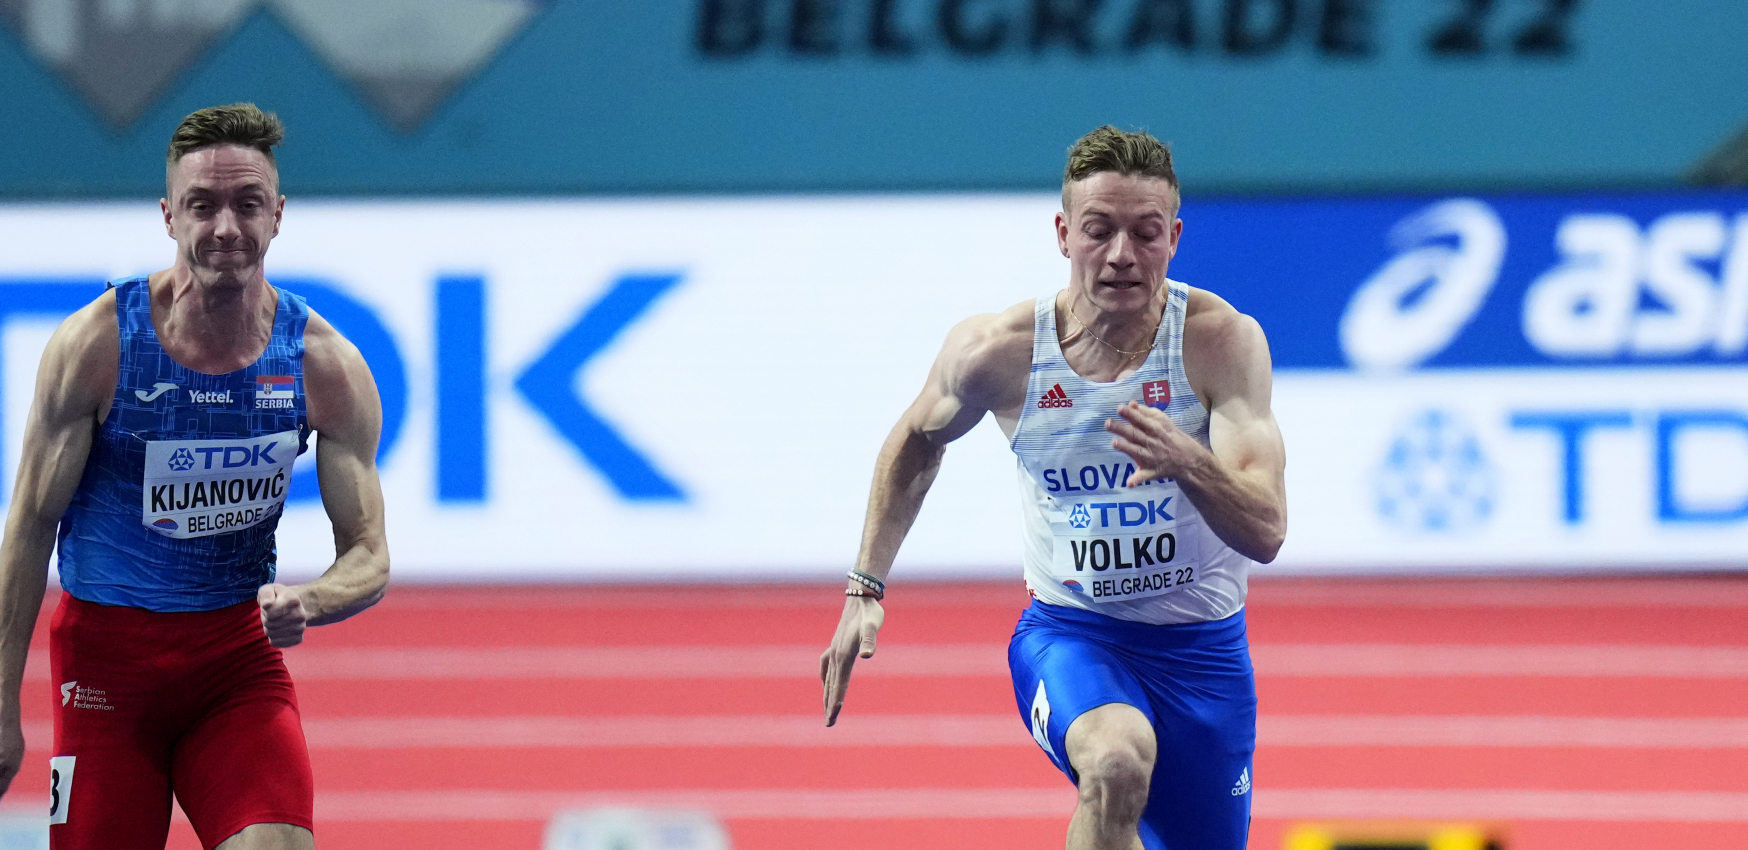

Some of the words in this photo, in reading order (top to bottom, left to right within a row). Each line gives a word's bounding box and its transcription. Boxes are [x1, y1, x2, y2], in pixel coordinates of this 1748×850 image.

[0, 273, 690, 507] DK
[188, 389, 234, 404] Yettel.
[255, 399, 295, 409] SERBIA
[1037, 397, 1073, 409] adidas
[195, 441, 279, 470] TDK
[150, 467, 286, 513] KIJANOVIĆ
[1043, 462, 1175, 492] SLOVA
[188, 507, 264, 534] BELGRADE
[1090, 496, 1175, 528] TDK
[1070, 532, 1176, 572] VOLKO
[1092, 571, 1172, 597] BELGRADE
[1175, 567, 1194, 585] 22
[74, 693, 107, 703] Athletics
[76, 686, 106, 696] Serbian
[73, 701, 115, 711] Federation
